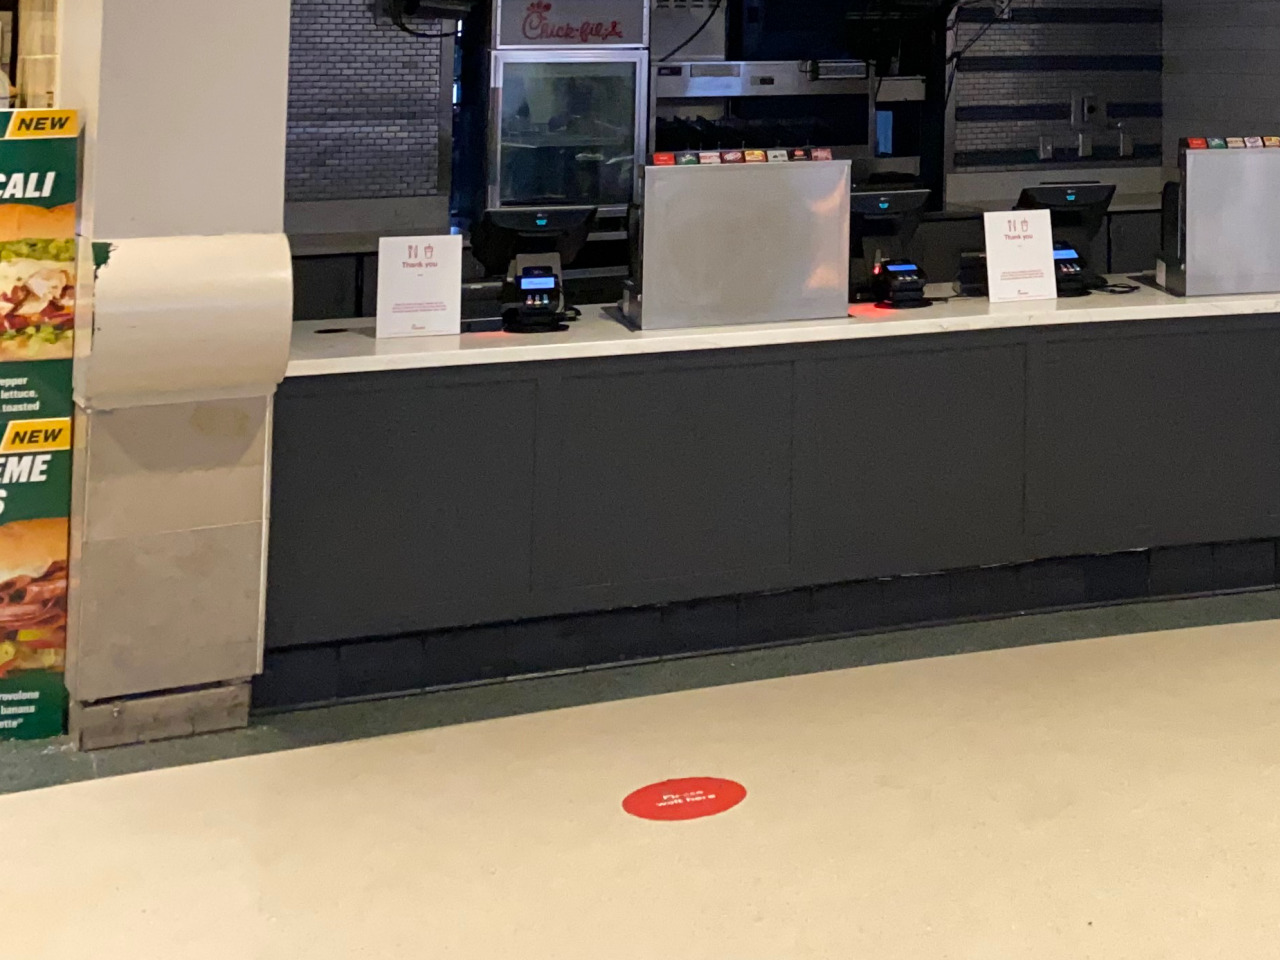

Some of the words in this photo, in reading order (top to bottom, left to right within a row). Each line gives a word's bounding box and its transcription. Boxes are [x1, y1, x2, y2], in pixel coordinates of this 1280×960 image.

[522, 1, 624, 43] Chick-fil-A
[17, 116, 70, 131] NEW
[11, 428, 63, 445] NEW
[0, 454, 52, 485] ME
